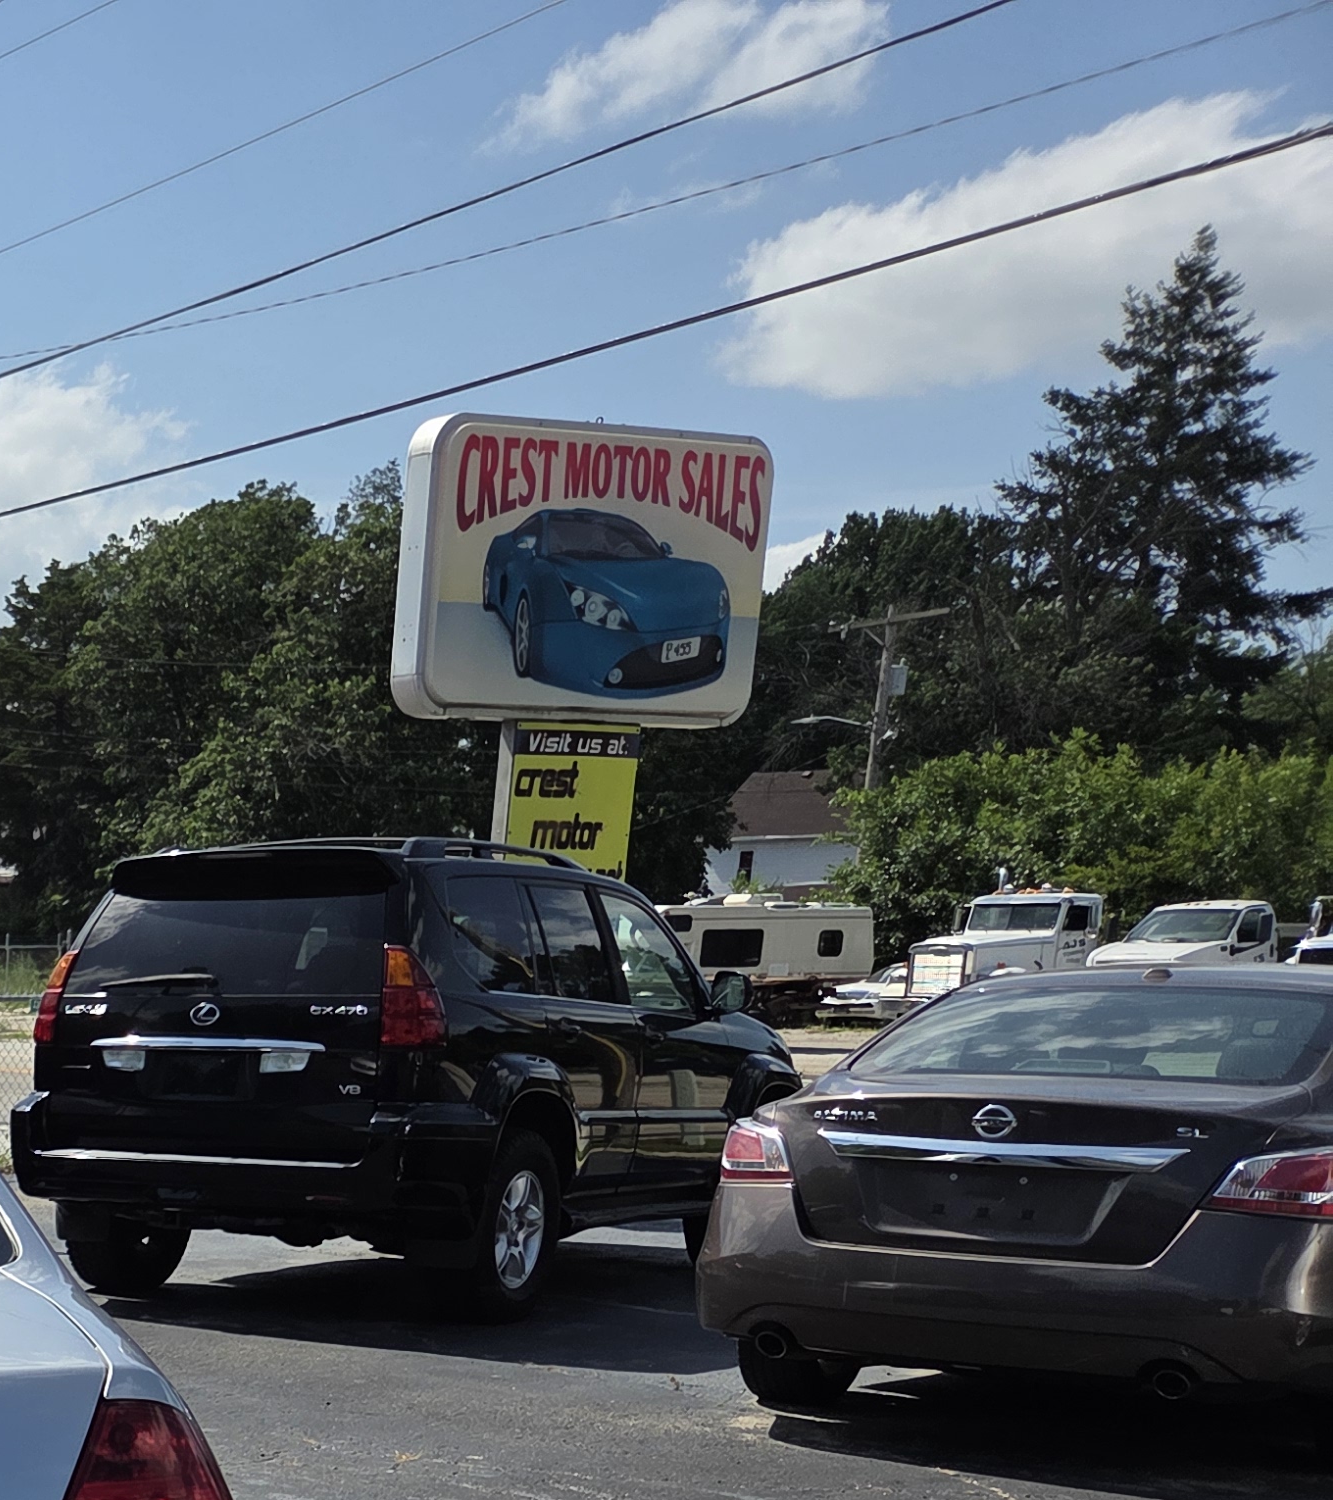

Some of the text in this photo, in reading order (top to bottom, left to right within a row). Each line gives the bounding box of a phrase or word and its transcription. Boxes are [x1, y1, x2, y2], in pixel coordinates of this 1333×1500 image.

[456, 433, 766, 552] CREST MOTOR SALES
[529, 731, 629, 756] Visit us at:
[514, 760, 580, 799] crest
[530, 812, 603, 851] motor
[338, 1084, 361, 1095] V8
[1176, 1126, 1210, 1139] SL
